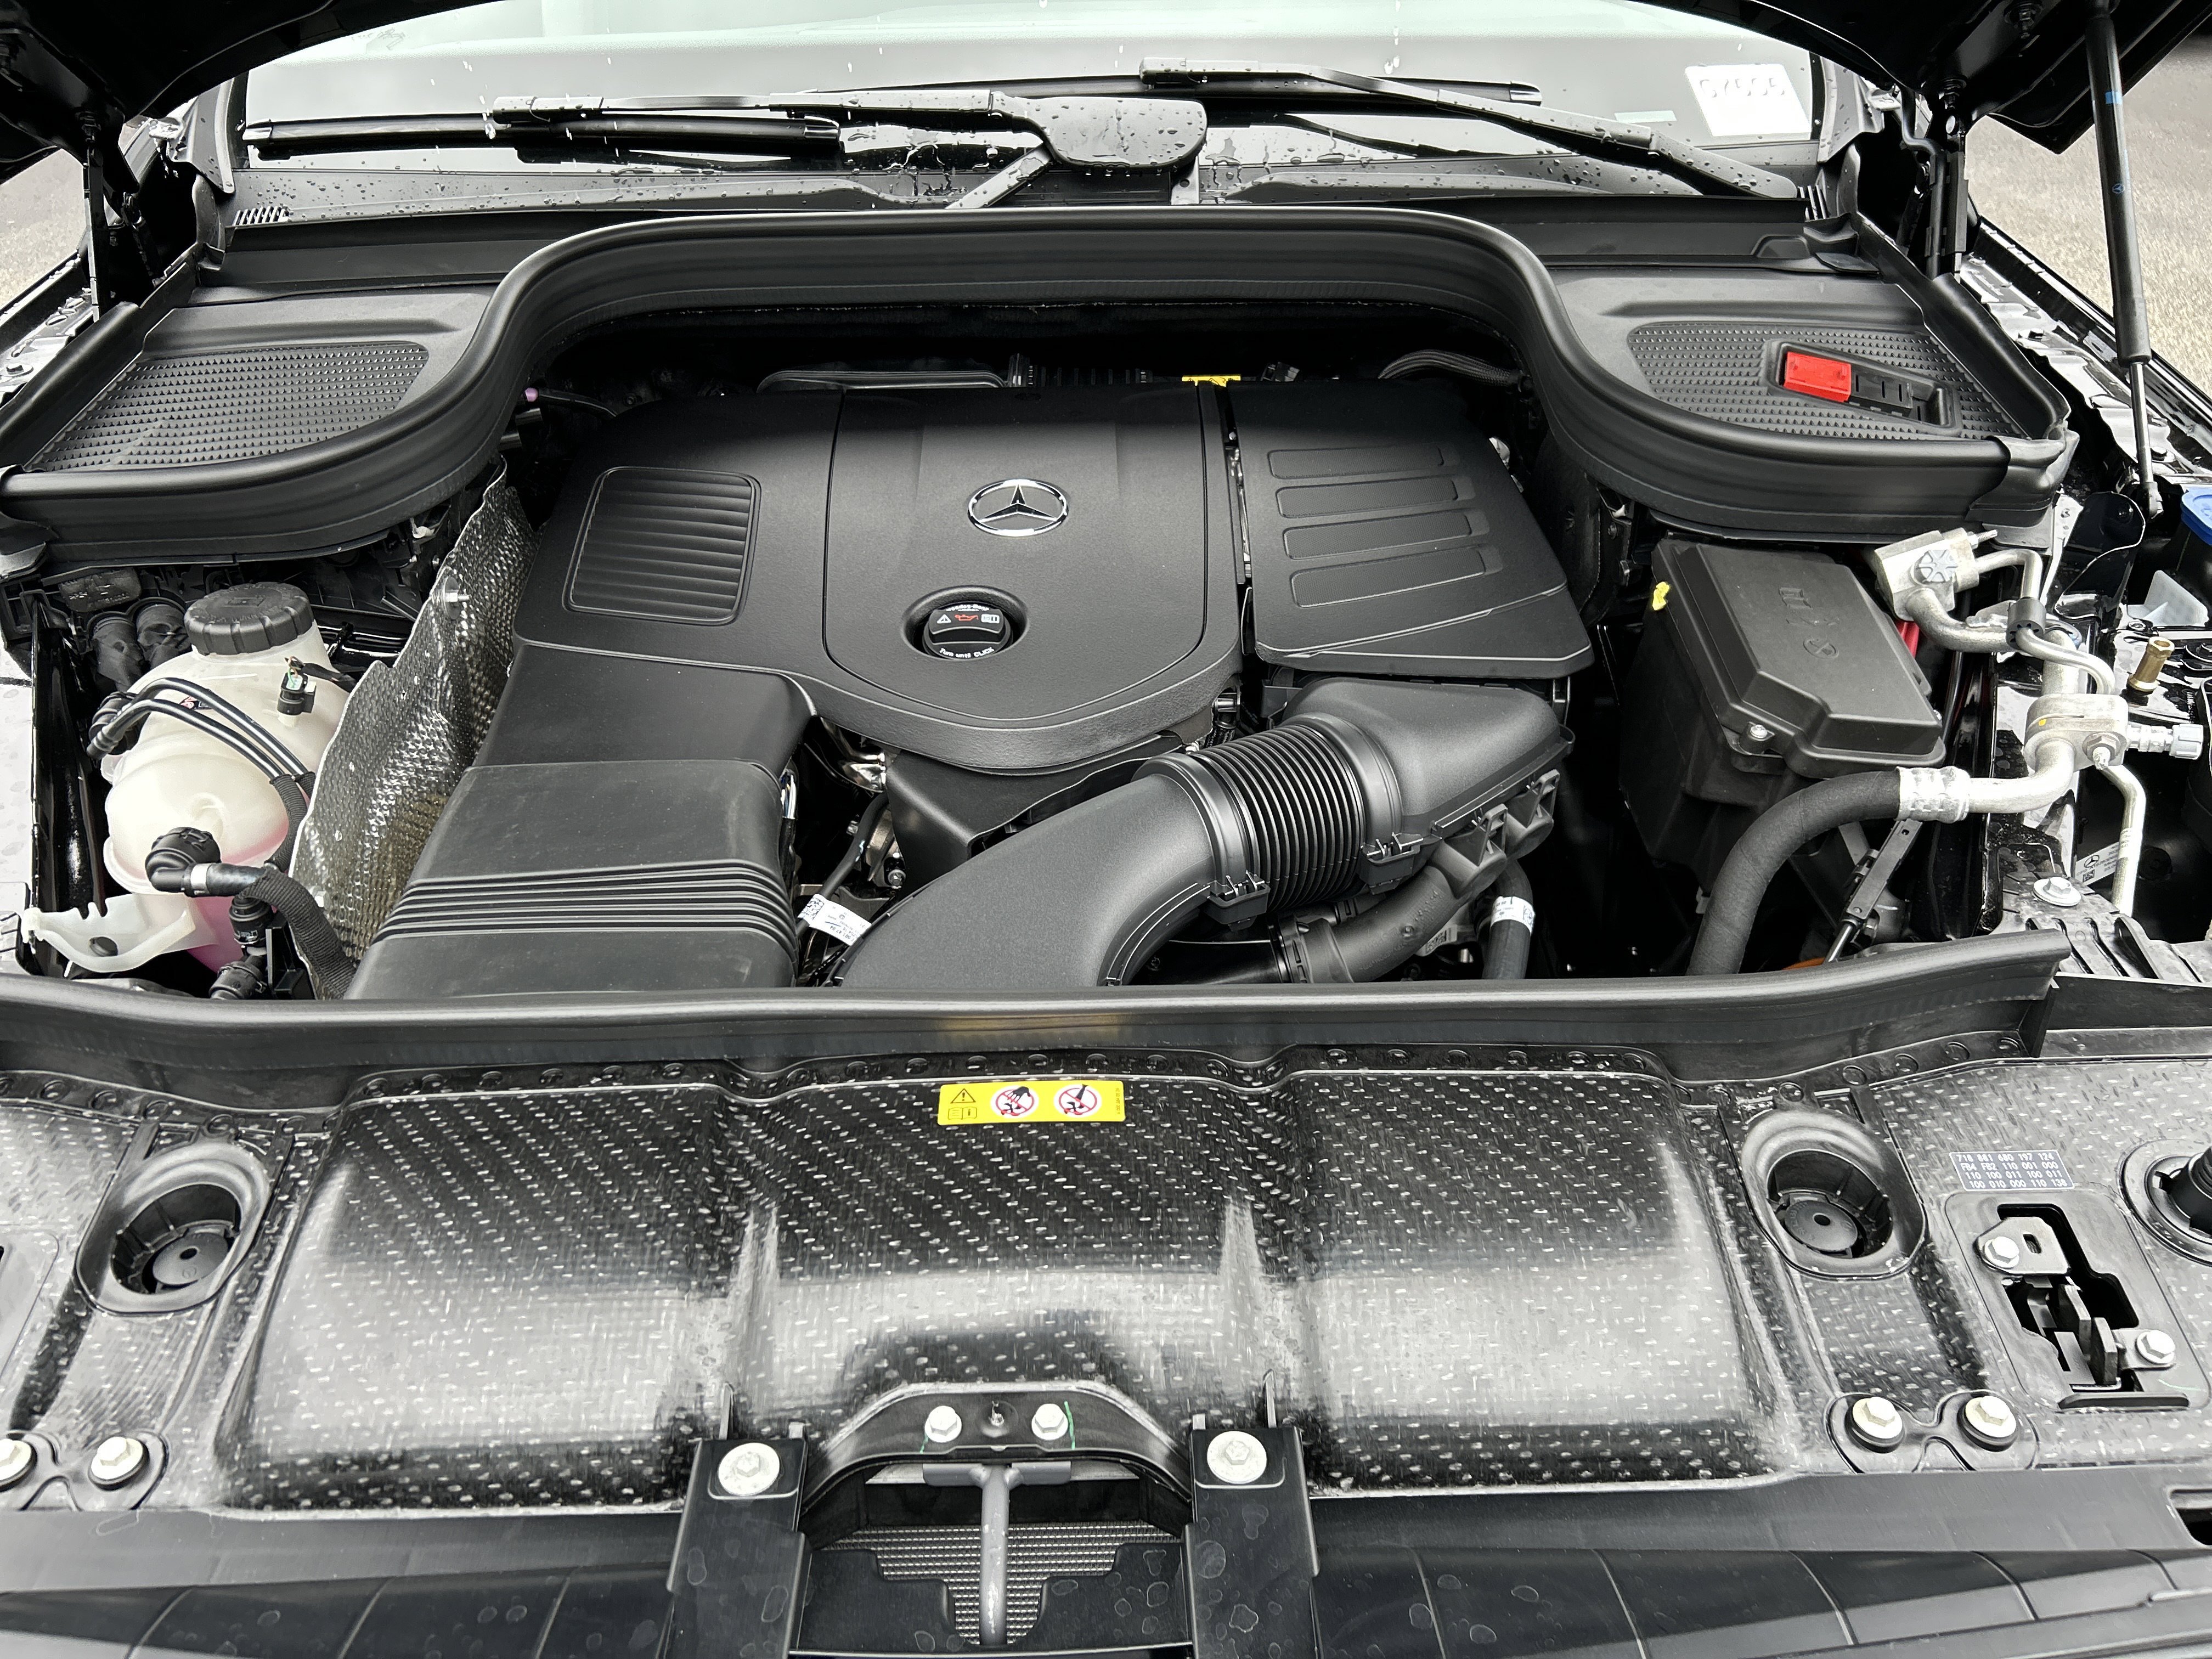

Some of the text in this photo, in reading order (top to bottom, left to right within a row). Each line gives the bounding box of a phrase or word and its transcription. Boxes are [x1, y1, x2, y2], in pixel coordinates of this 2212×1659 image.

[939, 647, 953, 657] Turn
[973, 647, 995, 657] CLICK
[1956, 1154, 1973, 1162] 718
[1997, 1153, 2014, 1161] 680
[2018, 1153, 2032, 1161] 197
[1960, 1163, 1977, 1171] FB4
[1980, 1163, 1997, 1171] FB2
[2002, 1162, 2018, 1170] 110
[2021, 1161, 2038, 1170] 001
[1965, 1171, 1982, 1180] 110
[2027, 1170, 2043, 1178] 100
[2046, 1170, 2062, 1178] 011
[1969, 1178, 2068, 1188] 100 010 000 110 138
